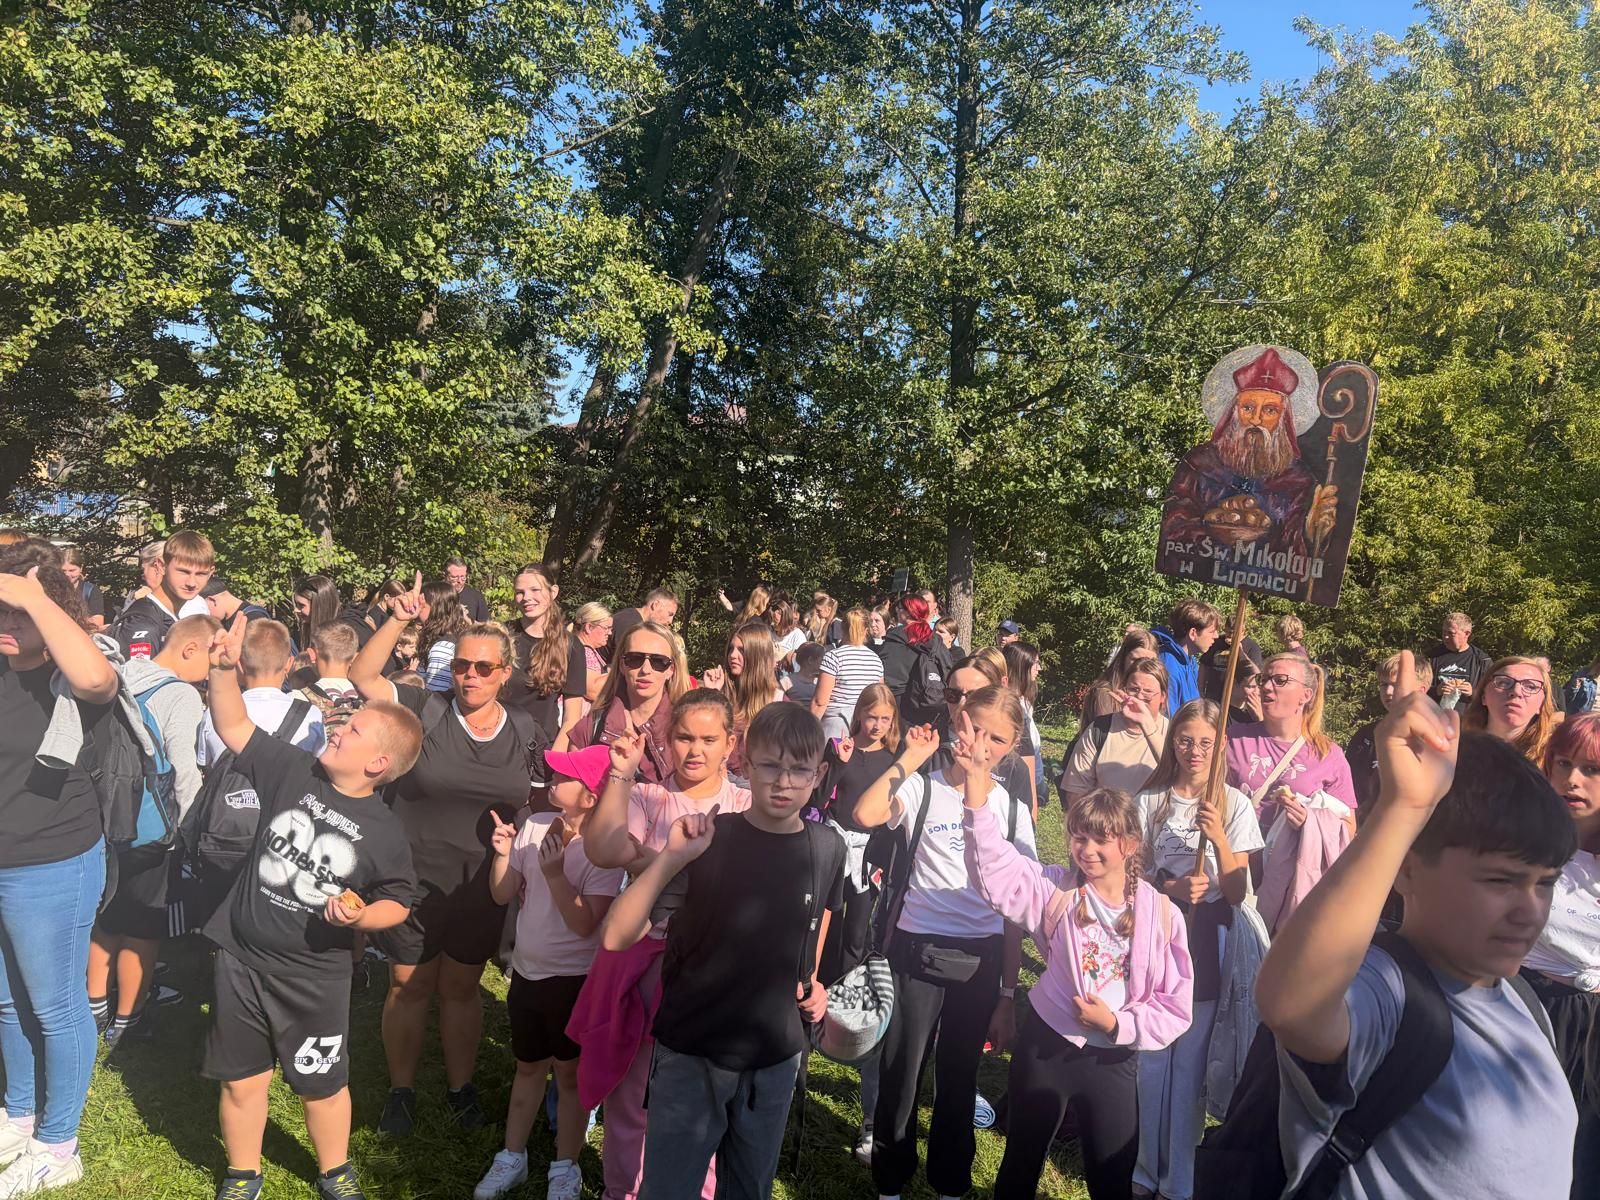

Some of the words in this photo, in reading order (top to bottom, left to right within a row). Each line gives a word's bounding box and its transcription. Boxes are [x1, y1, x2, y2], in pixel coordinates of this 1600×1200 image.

[1165, 541, 1194, 556] par.
[1200, 536, 1230, 561] Św.
[1234, 539, 1325, 583] Mikołaja
[1212, 560, 1298, 594] Lipowcu
[325, 808, 360, 833] KINDNESS
[928, 823, 949, 835] SON
[294, 1034, 343, 1075] 67
[318, 1056, 341, 1064] SEVEN
